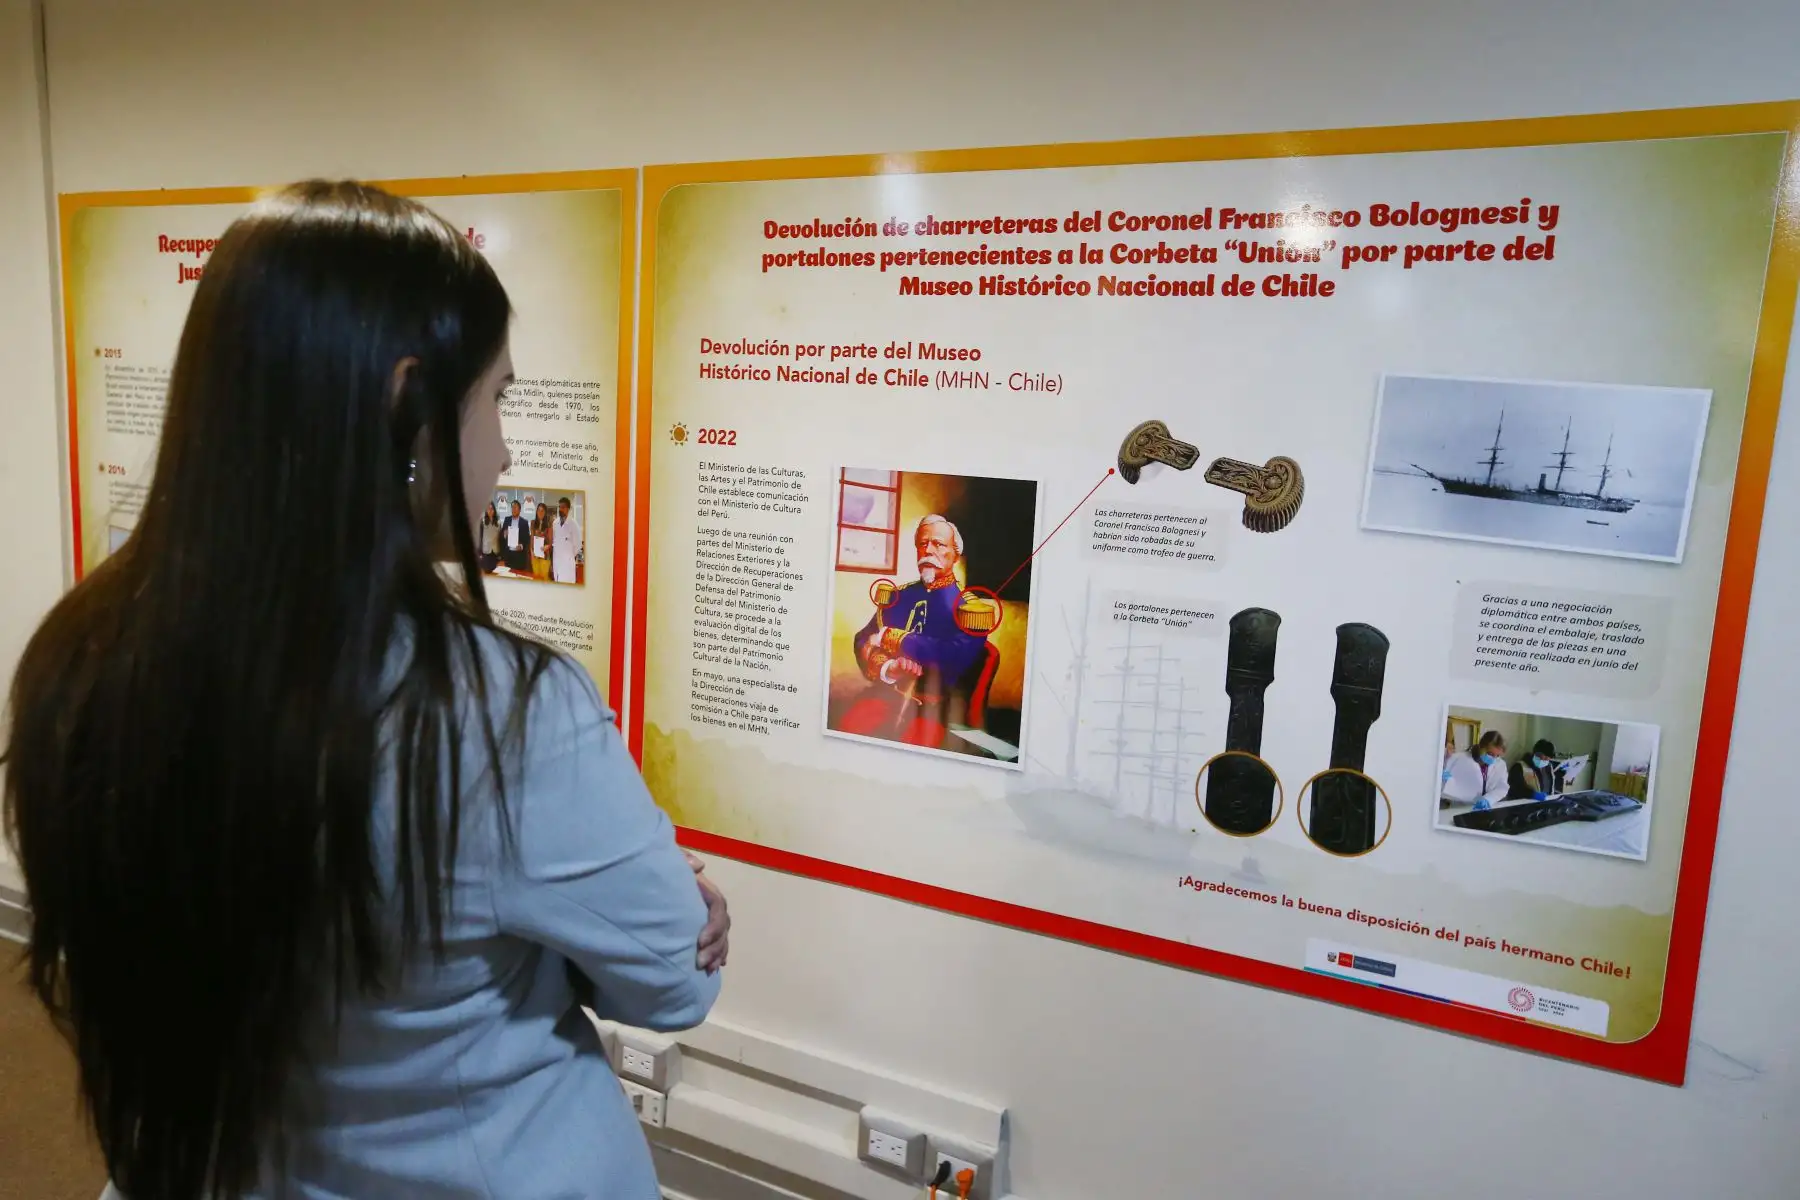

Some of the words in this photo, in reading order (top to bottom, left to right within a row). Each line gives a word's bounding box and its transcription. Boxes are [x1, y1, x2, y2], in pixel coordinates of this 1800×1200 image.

[763, 216, 878, 239] Devolución
[882, 218, 909, 238] de
[914, 214, 1058, 236] charreteras
[1063, 210, 1102, 233] del
[1107, 206, 1213, 232] Coronel
[1218, 203, 1361, 230] Francisco
[1369, 198, 1532, 233] Bolognesi
[1537, 205, 1560, 231] y
[762, 246, 876, 273] portalones
[879, 243, 1052, 273] pertenecientes
[1057, 249, 1074, 265] a
[1079, 242, 1104, 265] la
[1109, 241, 1218, 265] Corbeta
[1341, 244, 1398, 270] por
[1403, 239, 1496, 269] parte
[1502, 234, 1556, 261] del
[899, 275, 973, 296] Museo
[978, 273, 1091, 297] Histórico
[1097, 273, 1215, 297] Nacional
[1221, 273, 1256, 297] de
[1261, 272, 1336, 297] Chile
[104, 348, 122, 358] 2015
[700, 337, 790, 356] Devolución
[795, 344, 825, 361] por
[830, 342, 878, 362] parte
[883, 340, 912, 360] del
[918, 342, 981, 362] Museo
[539, 378, 581, 389] diplomáticas
[582, 381, 601, 389] entre
[699, 362, 771, 381] Histórico
[776, 365, 850, 384] Nacional
[855, 366, 878, 385] de
[883, 367, 929, 387] Chile
[935, 370, 989, 391] (MHN
[1008, 371, 1063, 395] Chile)
[547, 390, 573, 400] quienes
[538, 400, 559, 409] desde
[565, 401, 584, 411] 1970,
[590, 403, 600, 412] los
[526, 412, 560, 422] entregarlo
[576, 413, 600, 423] Estado
[697, 428, 737, 446] 2022
[699, 461, 706, 470] El
[707, 461, 745, 473] Ministerio
[746, 464, 757, 474] de
[758, 465, 770, 475] las
[770, 466, 806, 478] Culturas,
[698, 472, 709, 482] las
[709, 474, 731, 484] Artes
[731, 477, 737, 487] y
[738, 476, 746, 485] el
[747, 476, 789, 489] Patrimonio
[790, 480, 802, 490] de
[698, 484, 717, 495] Chile
[718, 487, 755, 498] establece
[755, 491, 809, 502] comunicación
[697, 498, 712, 506] con
[712, 497, 720, 507] el
[721, 498, 759, 510] Ministerio
[760, 501, 771, 511] de
[772, 503, 802, 514] Cultura
[697, 507, 710, 517] del
[710, 509, 730, 519] Perú.
[1094, 508, 1108, 517] Las
[1108, 509, 1153, 521] charreteras
[1152, 514, 1198, 524] pertenecen
[1199, 517, 1208, 525] al
[1094, 519, 1124, 530] Coronel
[1123, 522, 1160, 533] Francisco
[1161, 525, 1200, 536] Bolognesi
[1200, 530, 1207, 538] y
[1123, 533, 1140, 543] sido
[1140, 535, 1173, 546] robadas
[1173, 538, 1185, 547] de
[1185, 540, 1195, 548] su
[1092, 542, 1127, 553] uniforme
[1127, 547, 1149, 555] como
[1150, 548, 1175, 558] trofeo
[1175, 550, 1186, 559] de
[1187, 552, 1216, 562] guerra.
[1114, 600, 1127, 609] Los
[1127, 603, 1169, 614] portalones
[1169, 608, 1215, 619] pertenecen
[1482, 594, 1519, 606] Gracias
[1529, 600, 1549, 608] una
[1551, 601, 1613, 615] negociación
[1119, 612, 1128, 621] la
[1128, 613, 1159, 625] Corbeta
[1480, 606, 1539, 621] diplomática
[1540, 614, 1568, 624] entre
[1569, 616, 1604, 627] ambos
[1605, 620, 1641, 632] países,
[1492, 622, 1535, 633] coordina
[1537, 625, 1548, 634] el
[1548, 627, 1598, 642] embalaje,
[1601, 632, 1645, 645] traslado
[1477, 633, 1484, 642] y
[1485, 634, 1524, 646] entrega
[1525, 637, 1539, 647] de
[1540, 638, 1555, 649] las
[1556, 641, 1589, 652] piezas
[1590, 646, 1604, 654] en
[1606, 648, 1627, 656] una
[1474, 659, 1517, 670] presente
[1518, 663, 1540, 673] año.
[1476, 646, 1528, 658] ceremonia
[1529, 651, 1576, 664] realizada
[1591, 657, 1619, 669] junio
[1621, 661, 1639, 671] del
[691, 678, 698, 688] la
[699, 680, 734, 694] Dirección
[735, 686, 745, 696] de
[692, 667, 702, 677] En
[703, 671, 725, 683] mayo,
[726, 676, 741, 684] una
[742, 678, 786, 692] especialista
[787, 683, 798, 694] de
[691, 690, 748, 708] Recuperaciones
[749, 701, 767, 713] viaja
[768, 704, 779, 714] de
[690, 703, 723, 715] comisión
[730, 708, 750, 720] Chile
[750, 714, 768, 723] para
[769, 717, 800, 729] verificar
[690, 712, 701, 722] los
[702, 714, 726, 727] bienes
[738, 721, 746, 731] el
[747, 722, 770, 735] MHN.
[1178, 875, 1278, 904] ¡Agradecemos
[1281, 893, 1294, 908] la
[1298, 897, 1342, 918] buena
[1346, 908, 1430, 936] disposición
[1434, 926, 1460, 942] del
[1463, 935, 1496, 950] país
[1501, 939, 1575, 967] hermano
[1580, 957, 1631, 979] Chile!
